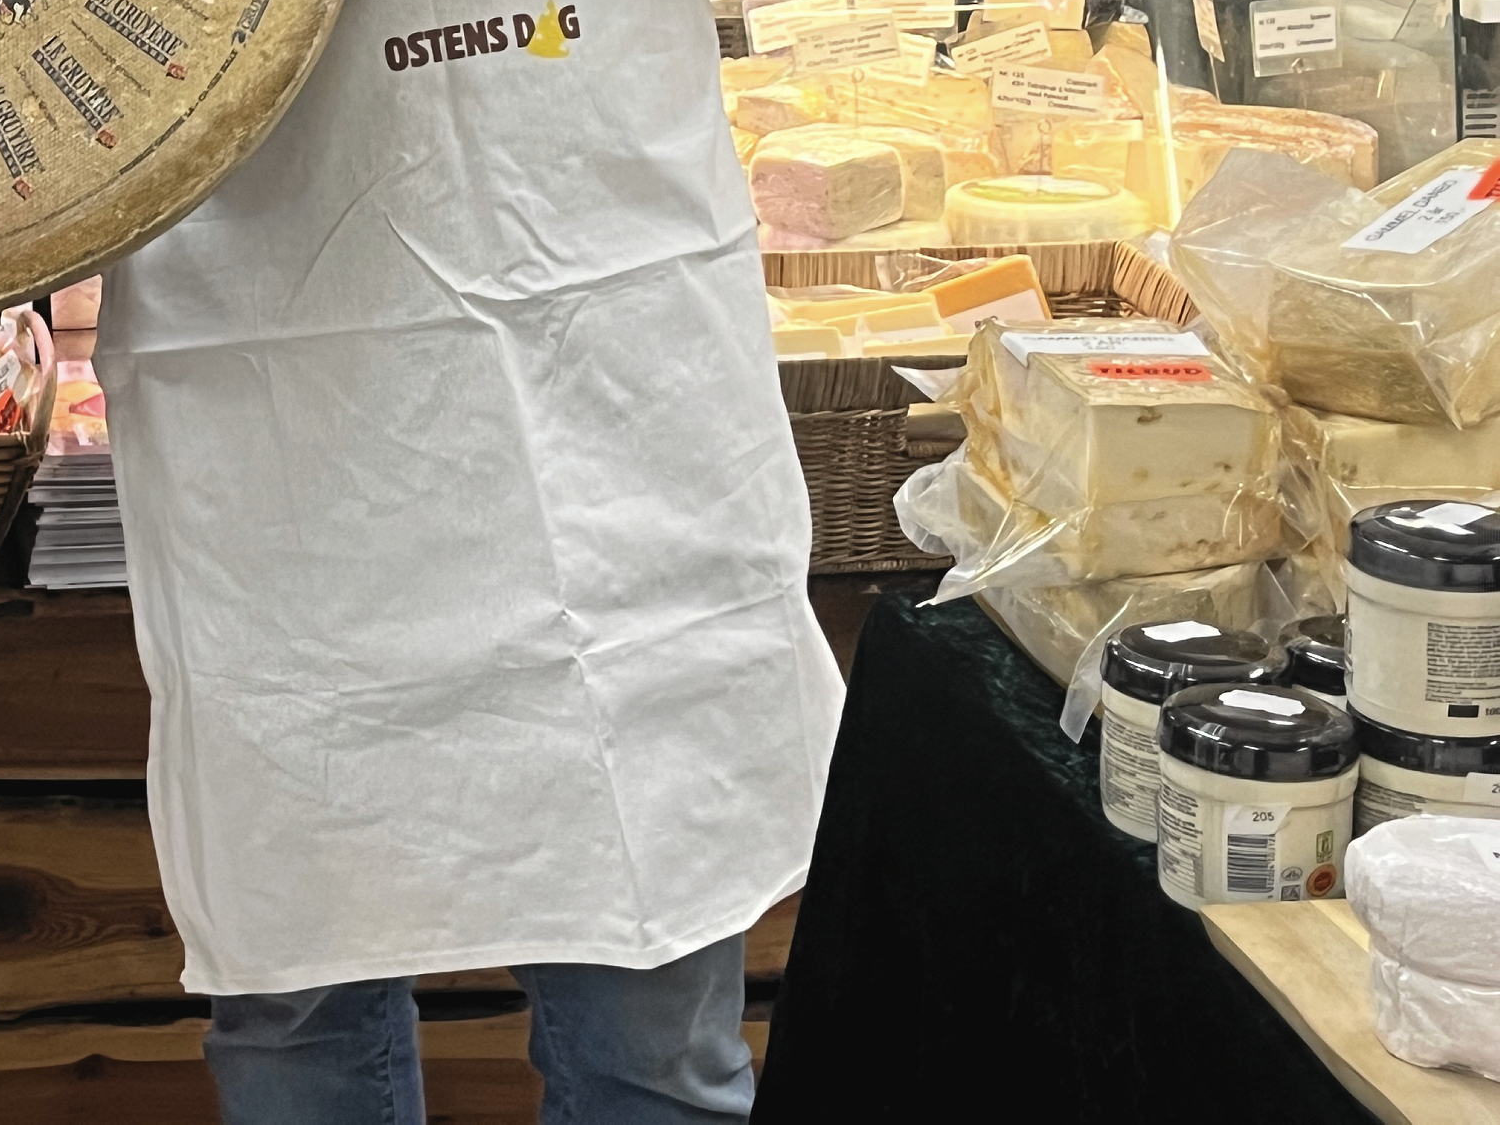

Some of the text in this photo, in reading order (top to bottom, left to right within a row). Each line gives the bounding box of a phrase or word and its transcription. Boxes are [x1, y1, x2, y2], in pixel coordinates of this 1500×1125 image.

[41, 33, 63, 61] LE
[385, 17, 508, 72] OSTENS
[1252, 811, 1275, 822] 205
